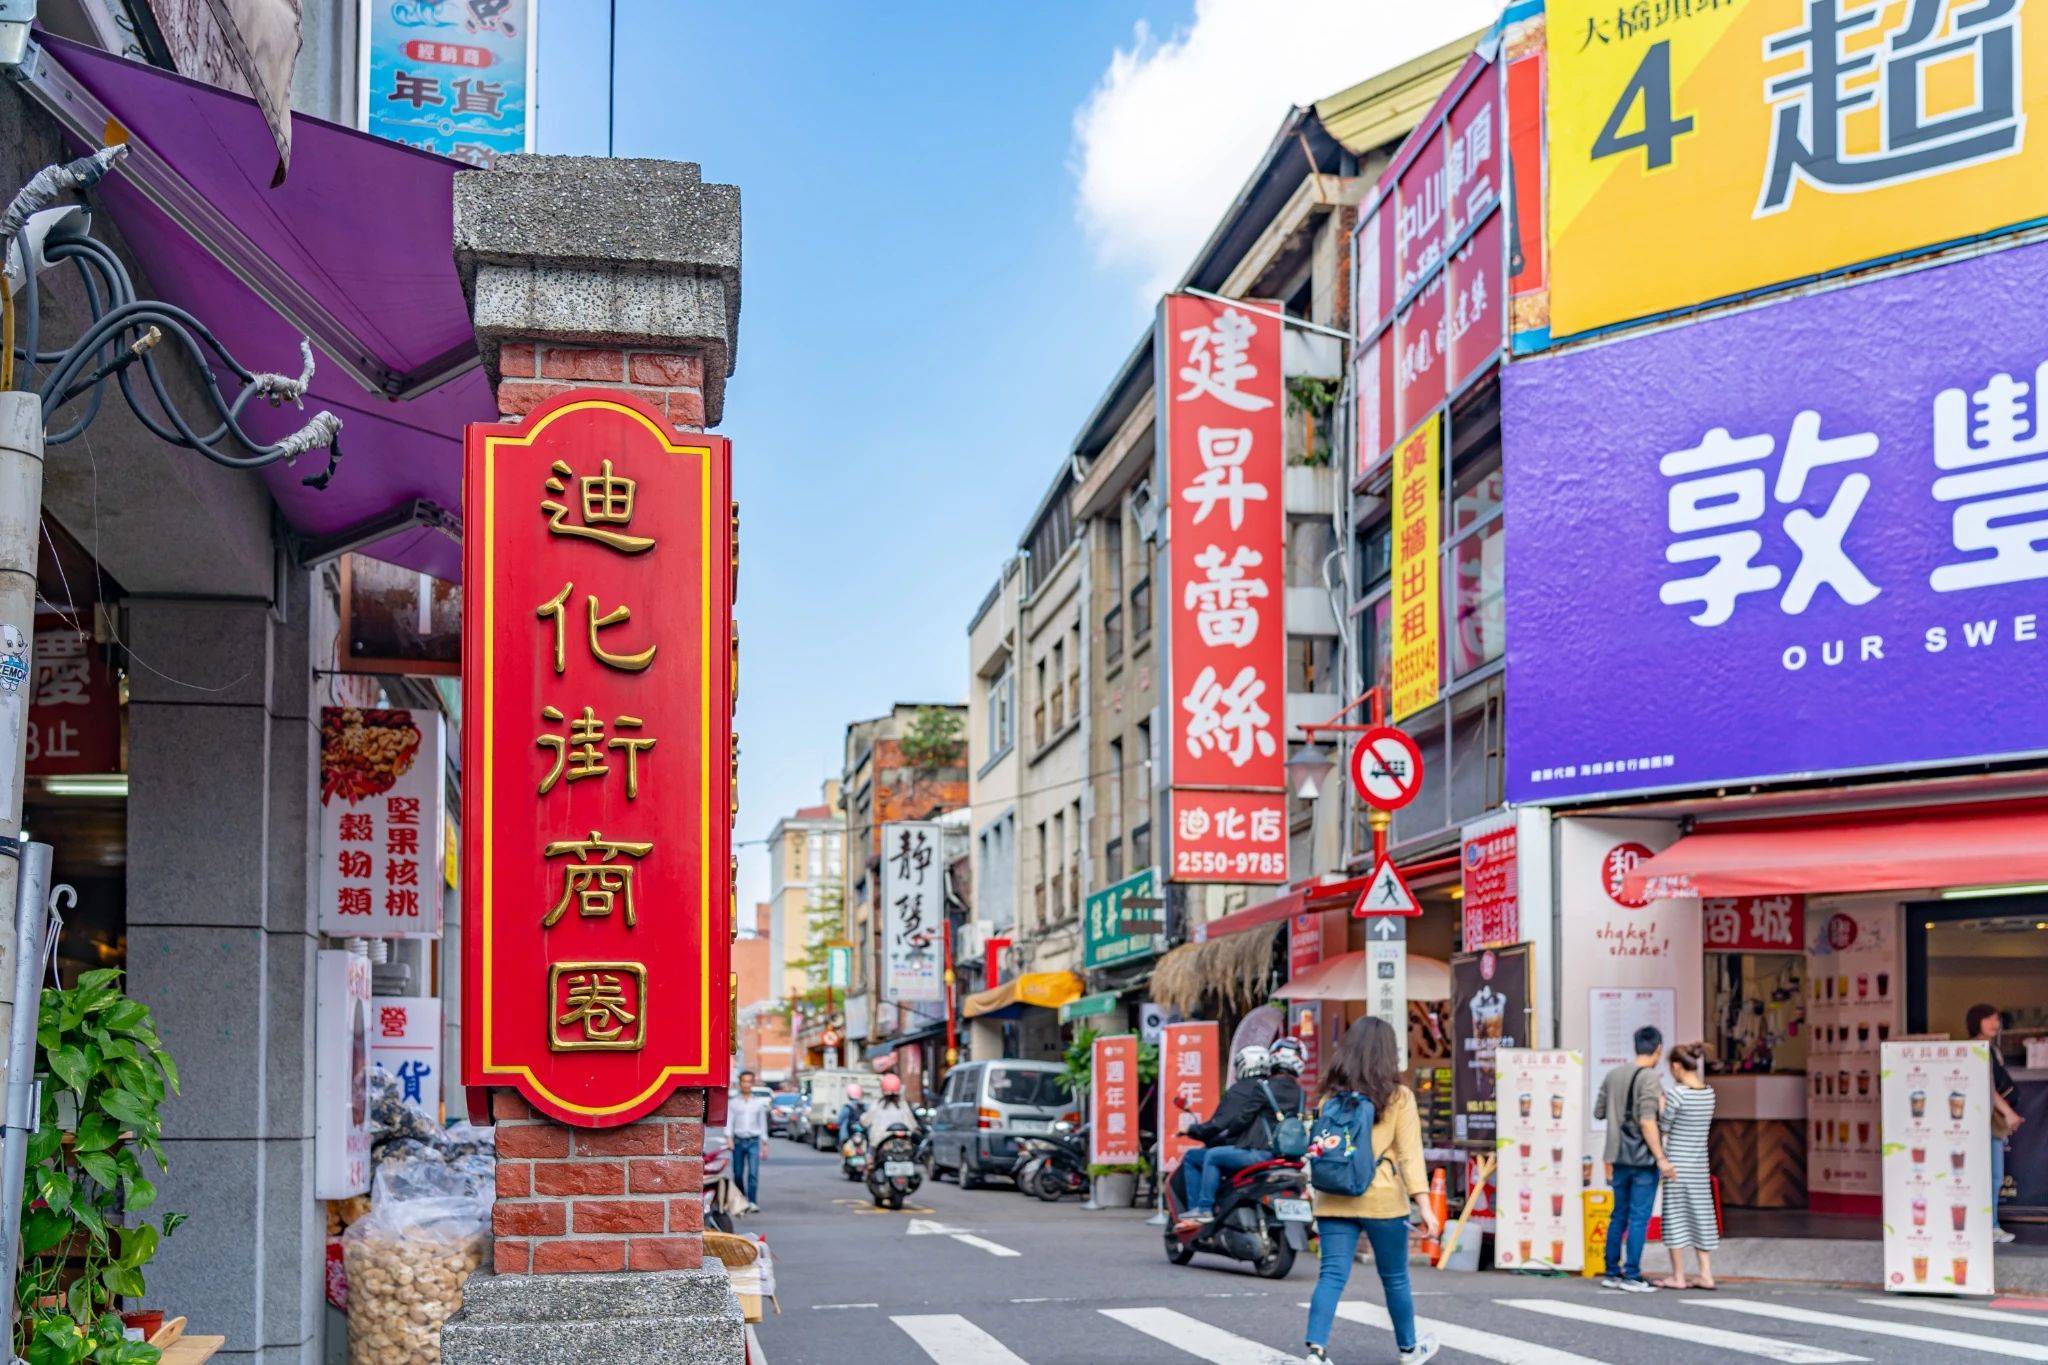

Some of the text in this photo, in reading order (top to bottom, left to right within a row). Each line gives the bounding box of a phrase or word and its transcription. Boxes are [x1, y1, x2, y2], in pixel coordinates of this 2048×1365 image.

[417, 43, 481, 67] 經銷商
[1576, 0, 1733, 55] 大橋頭
[387, 70, 506, 120] 年貨
[1589, 38, 1694, 170] 4
[1751, 0, 2027, 220] 超
[1176, 306, 1276, 768] 建昇蕾絲
[1400, 431, 1428, 648] 廣告牆出租
[1781, 613, 2038, 671] OUR SWE
[535, 456, 658, 1054] 迪化街商圈
[1179, 806, 1282, 842] 迪化店
[337, 813, 374, 917] 穀物類
[385, 796, 420, 918] 堅果核桃
[1177, 851, 1285, 875] 2550-9785
[1596, 921, 1656, 941] shake!
[1703, 895, 1793, 945] 商城
[1610, 938, 1669, 958] shake!
[371, 1006, 407, 1038] 營
